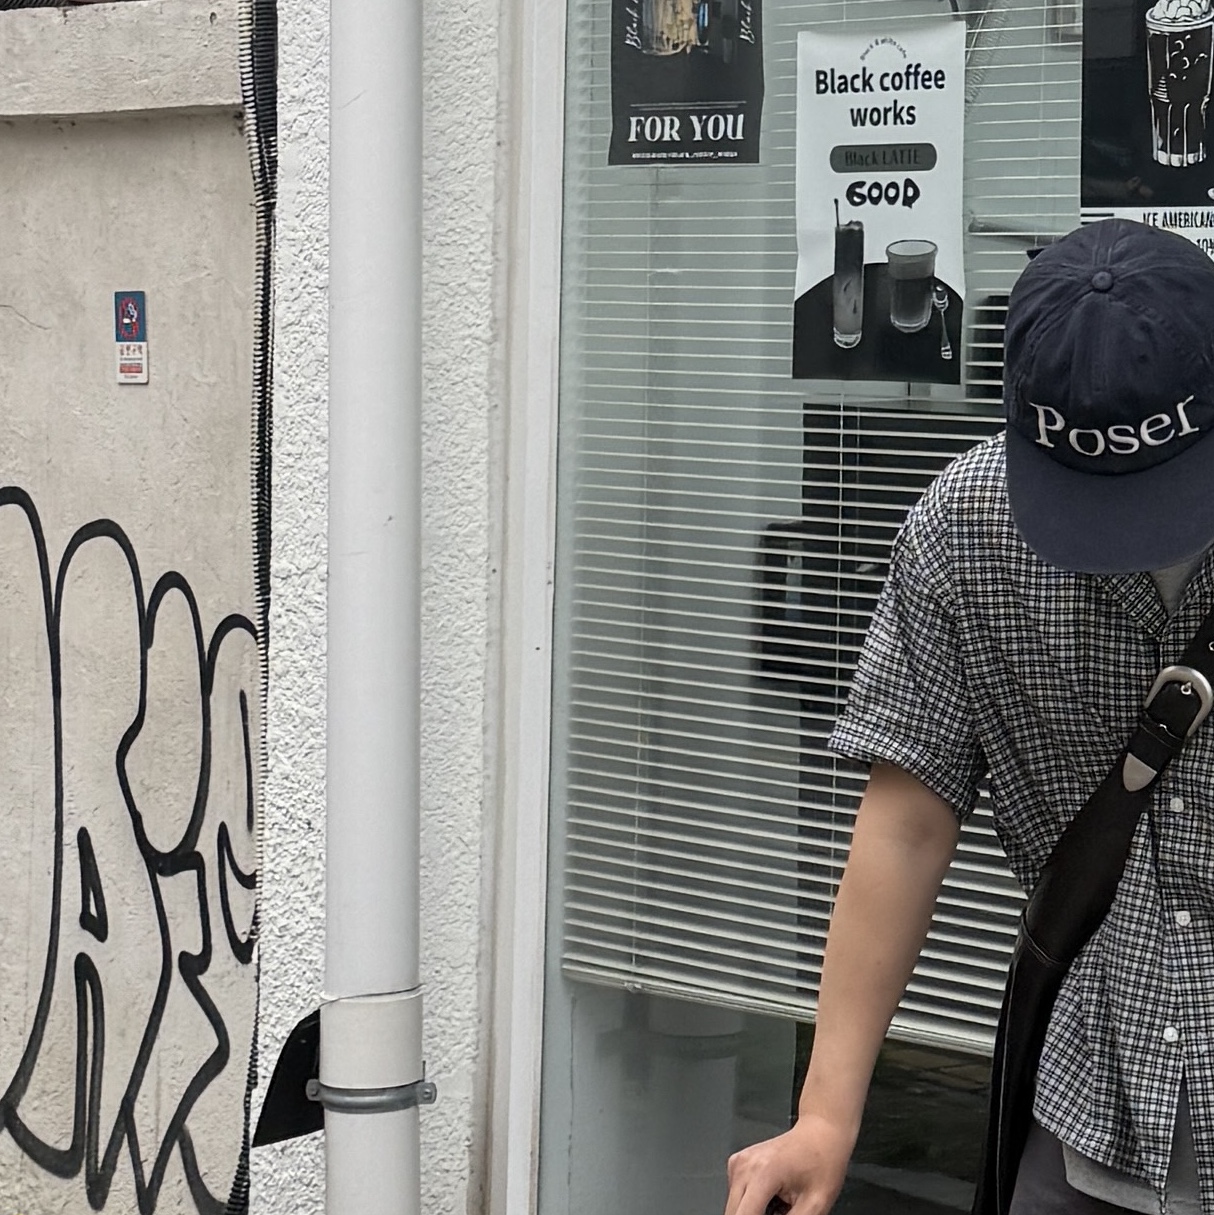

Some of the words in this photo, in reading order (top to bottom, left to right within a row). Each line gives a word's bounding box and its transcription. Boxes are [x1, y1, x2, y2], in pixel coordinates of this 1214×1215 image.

[816, 67, 875, 95] Black
[880, 63, 946, 91] coffee
[628, 116, 681, 142] FOR
[690, 114, 745, 141] YOU
[850, 99, 917, 127] works
[846, 178, 920, 209] GOOD
[1029, 394, 1200, 457] Poser
